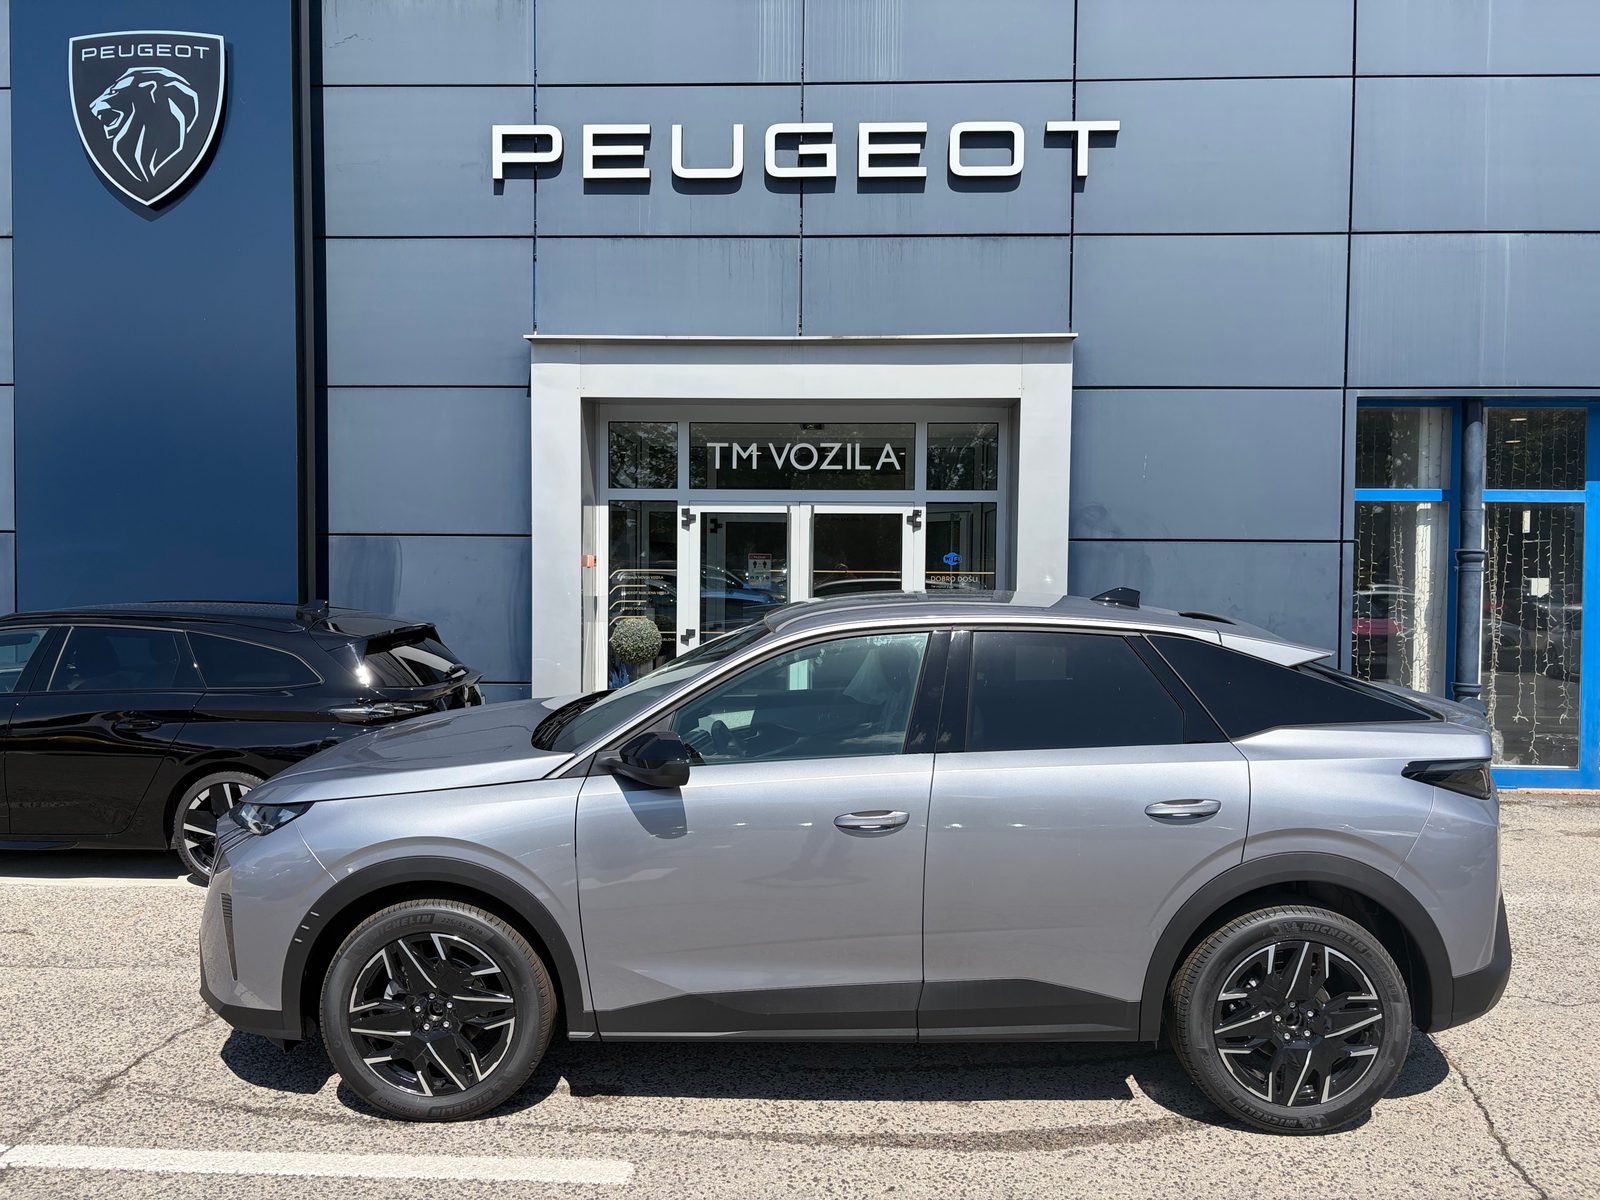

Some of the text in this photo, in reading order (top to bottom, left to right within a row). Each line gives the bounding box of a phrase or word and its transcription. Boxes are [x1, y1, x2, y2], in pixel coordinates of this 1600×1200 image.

[81, 44, 209, 61] PEUGEOT
[492, 120, 1121, 179] PEUGEOT
[707, 443, 901, 470] TM VOZILA
[957, 574, 978, 583] DOŠLI
[1302, 921, 1368, 955] MICHELIN
